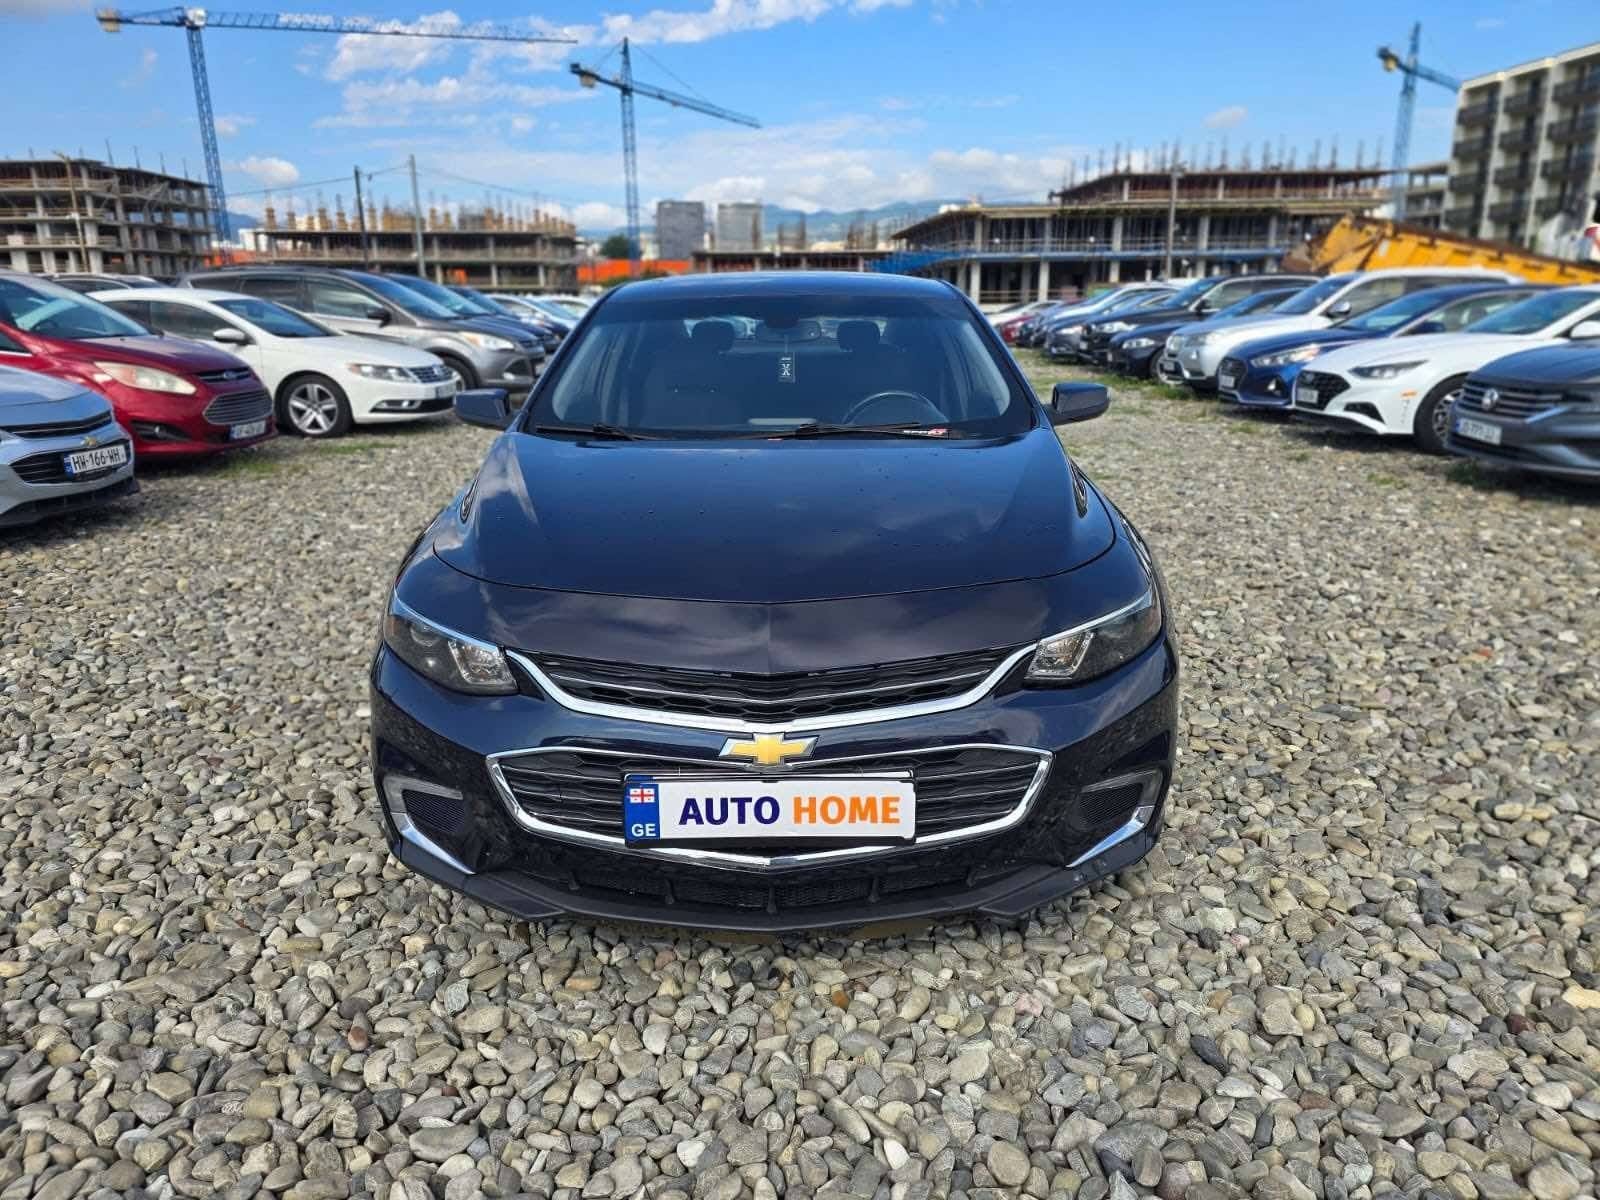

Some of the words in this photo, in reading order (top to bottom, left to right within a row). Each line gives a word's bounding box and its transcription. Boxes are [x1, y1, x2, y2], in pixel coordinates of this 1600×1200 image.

[679, 796, 780, 825] AUTO
[793, 796, 900, 824] HOME
[631, 823, 656, 837] GE
